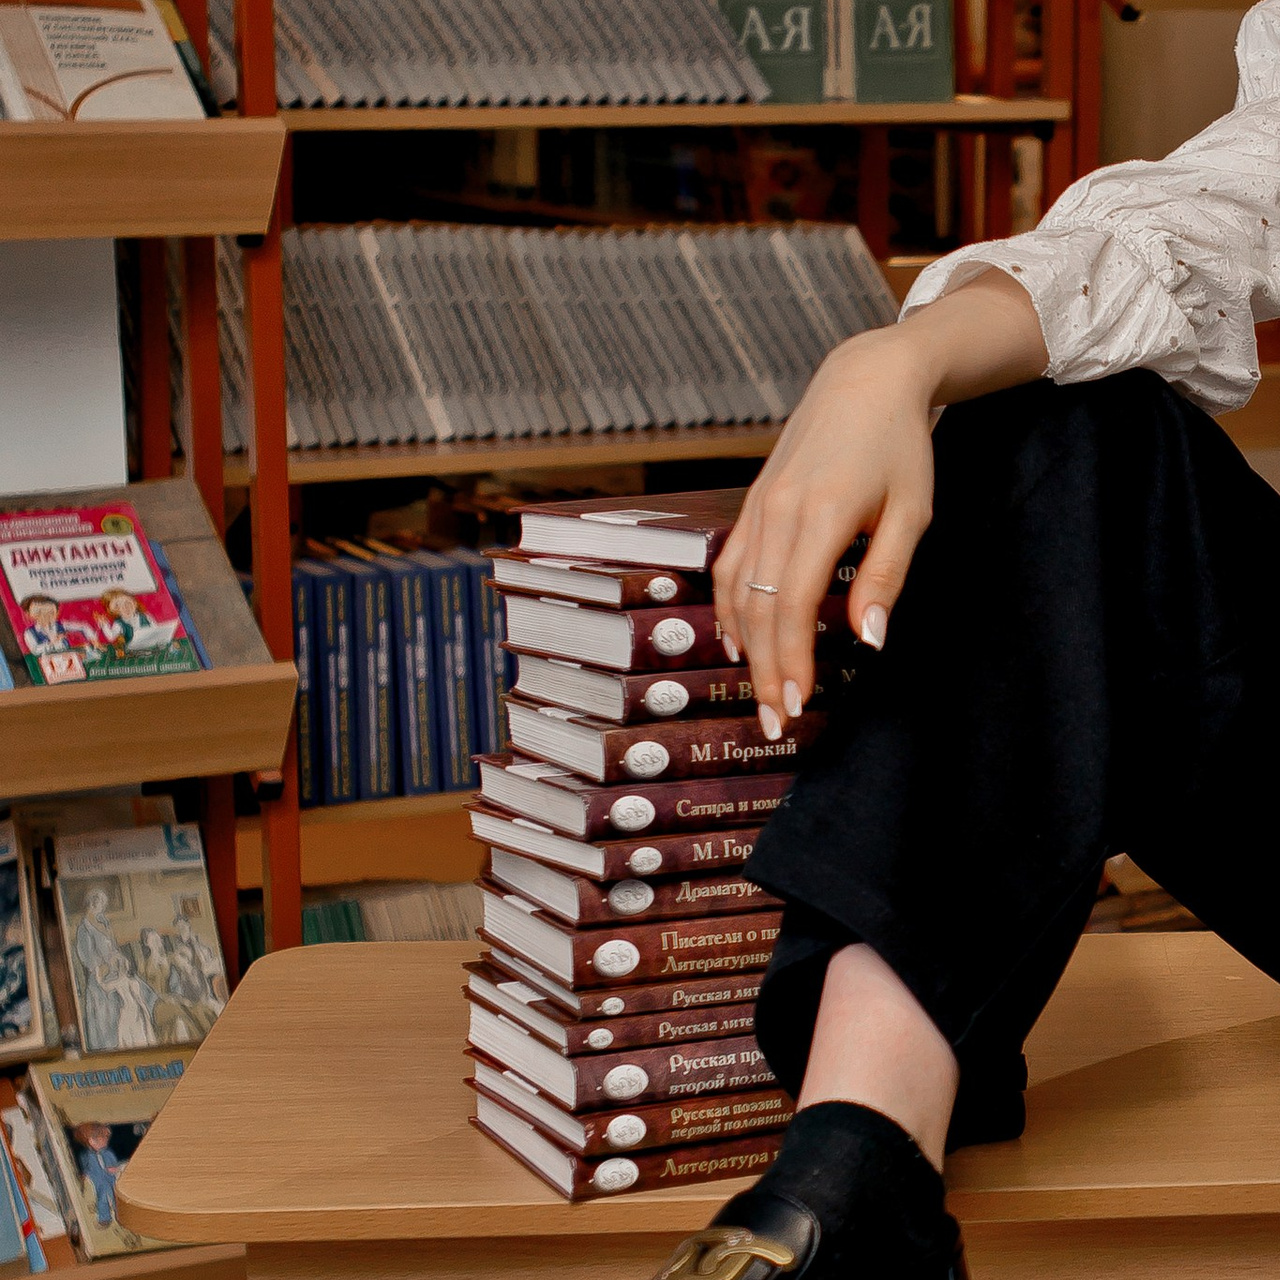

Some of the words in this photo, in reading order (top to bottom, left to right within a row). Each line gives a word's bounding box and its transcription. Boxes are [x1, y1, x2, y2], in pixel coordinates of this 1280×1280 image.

[10, 541, 133, 568] ДИКТАНТЫ
[690, 743, 718, 762] М.
[723, 738, 797, 762] Горький
[676, 799, 734, 818] Сатира
[738, 801, 748, 811] и
[692, 841, 719, 861] М.
[661, 930, 742, 950] Писатели
[746, 930, 757, 941] о
[672, 989, 731, 1008] Русская
[658, 1021, 718, 1039] Русская
[669, 1053, 736, 1075] Русская
[49, 1065, 133, 1091] РУССКИЙ
[668, 1073, 725, 1095] второй
[670, 1107, 730, 1125] Русская
[733, 1097, 782, 1115] поэзия
[670, 1120, 722, 1139] первой
[660, 1151, 769, 1178] Литература
